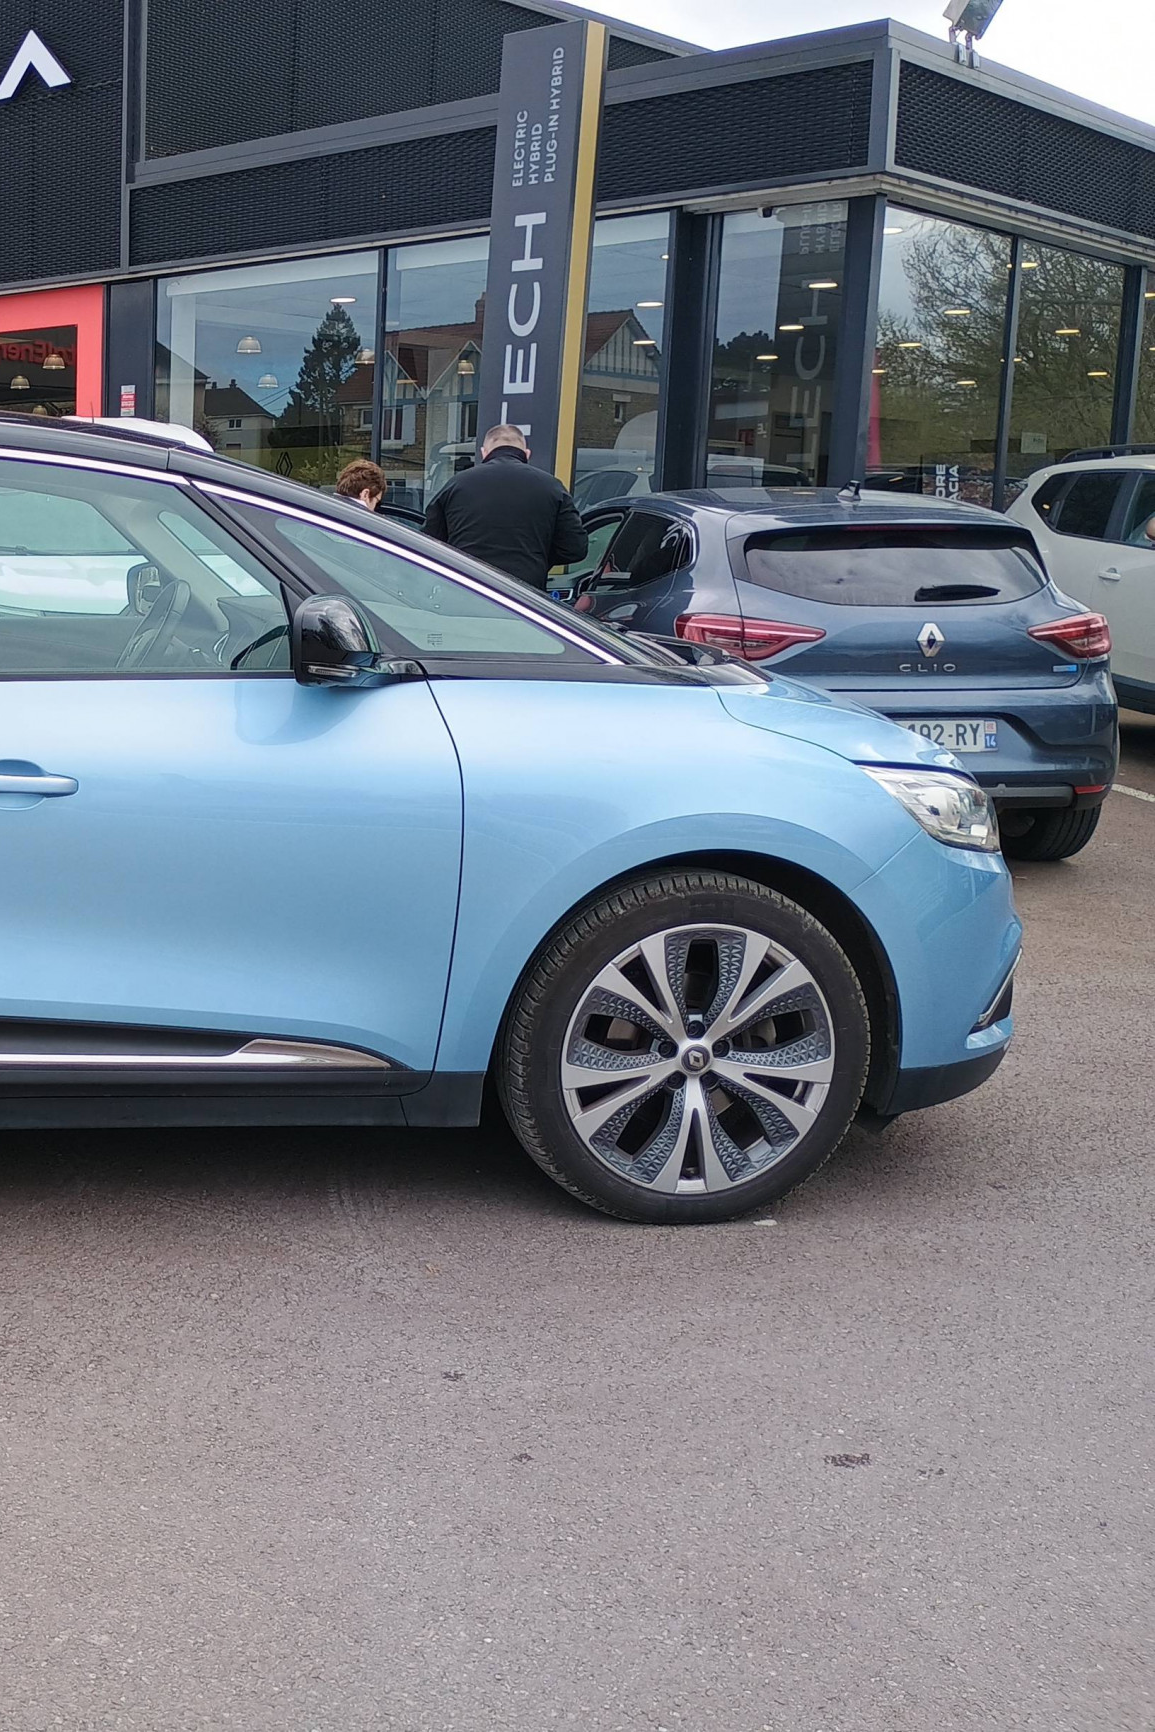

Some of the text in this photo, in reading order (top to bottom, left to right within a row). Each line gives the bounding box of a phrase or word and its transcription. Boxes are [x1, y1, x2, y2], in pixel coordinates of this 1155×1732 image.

[512, 109, 529, 187] ELECTRIC
[544, 46, 565, 183] PLUG-IN HYBRID
[528, 122, 543, 185] HYBRID
[899, 663, 956, 673] CLIO
